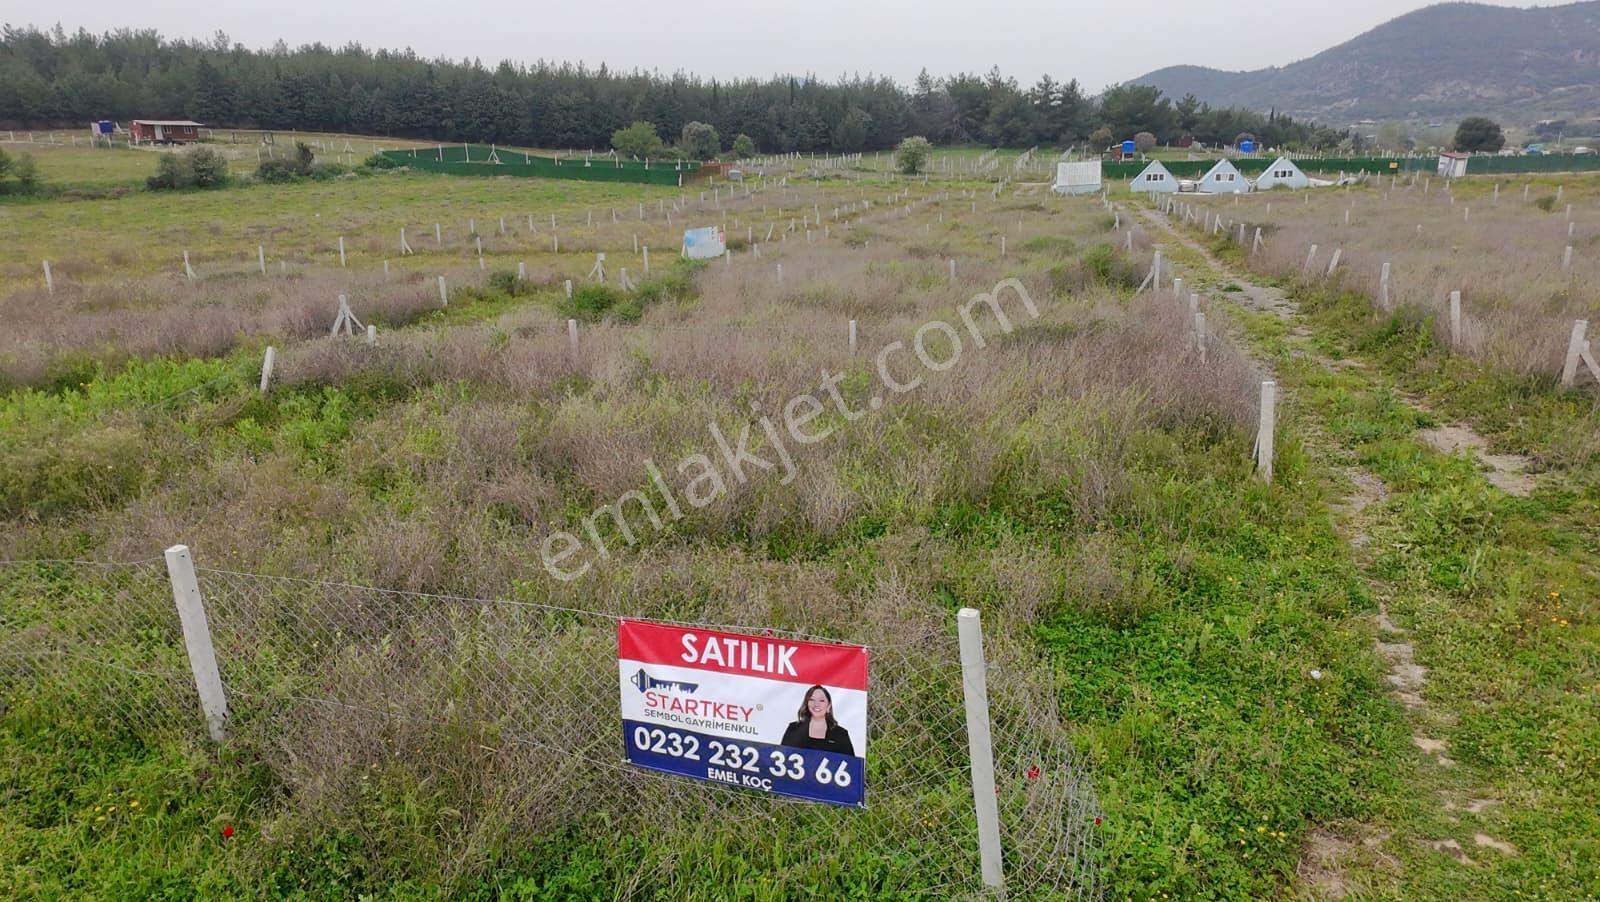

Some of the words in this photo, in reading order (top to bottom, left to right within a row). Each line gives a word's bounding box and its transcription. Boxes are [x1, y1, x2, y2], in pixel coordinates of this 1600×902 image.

[681, 633, 798, 676] SATILIK
[644, 708, 683, 724] SEMBOL
[685, 717, 759, 735] GAYRİMENKUL
[645, 692, 754, 722] STARTKEY
[634, 727, 700, 760] 0232
[708, 741, 760, 773] 232
[769, 751, 805, 780] 33
[815, 757, 851, 787] 66
[707, 768, 739, 784] EMEL
[742, 776, 772, 792] KOÇ
